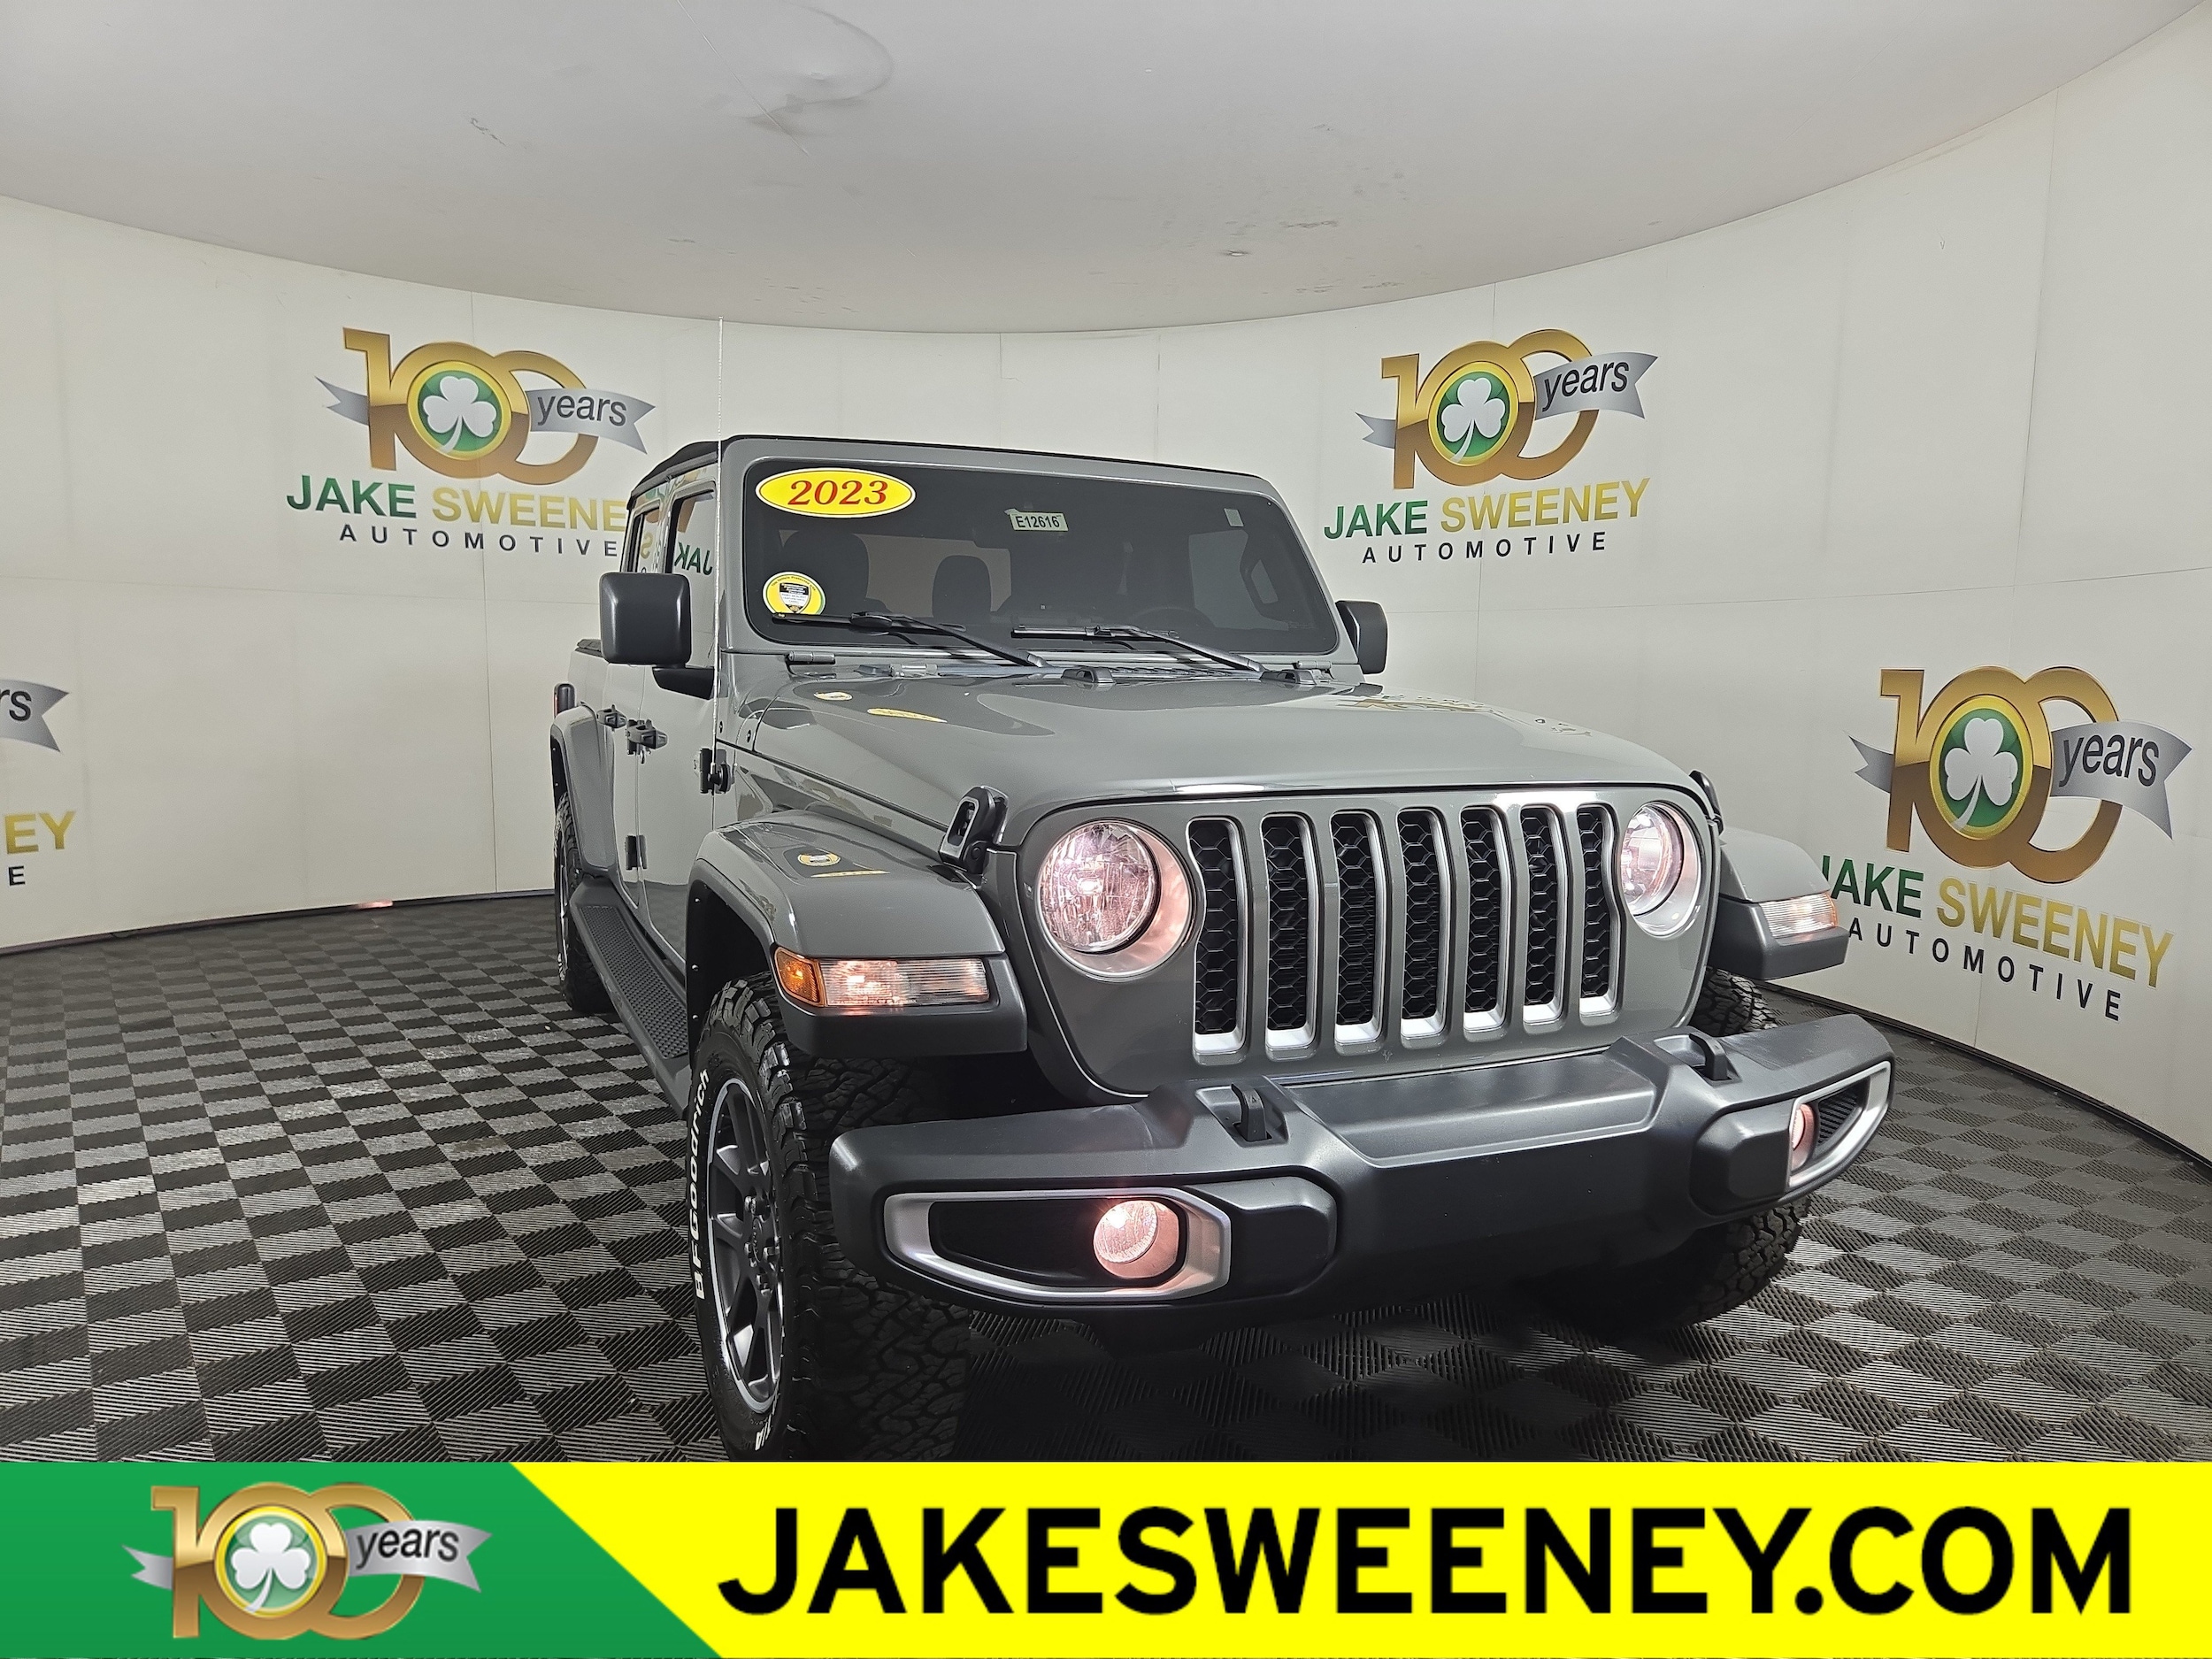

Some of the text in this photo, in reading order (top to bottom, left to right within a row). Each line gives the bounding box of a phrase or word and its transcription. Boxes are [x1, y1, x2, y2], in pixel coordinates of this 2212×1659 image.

[537, 395, 627, 426] years
[1541, 360, 1631, 413] years
[287, 474, 626, 533] JAKE SWEENE
[787, 480, 888, 504] 2023
[1324, 478, 1651, 539] JAKE SWEENEY
[340, 524, 618, 557] AUTOMOTIVE
[1015, 516, 1060, 528] E12616
[1362, 532, 1607, 564] AUTOMOTIVE
[2058, 734, 2160, 787] years
[1936, 877, 2175, 989] SWEENEY
[1848, 917, 2122, 1022] AUTOMOTIVE
